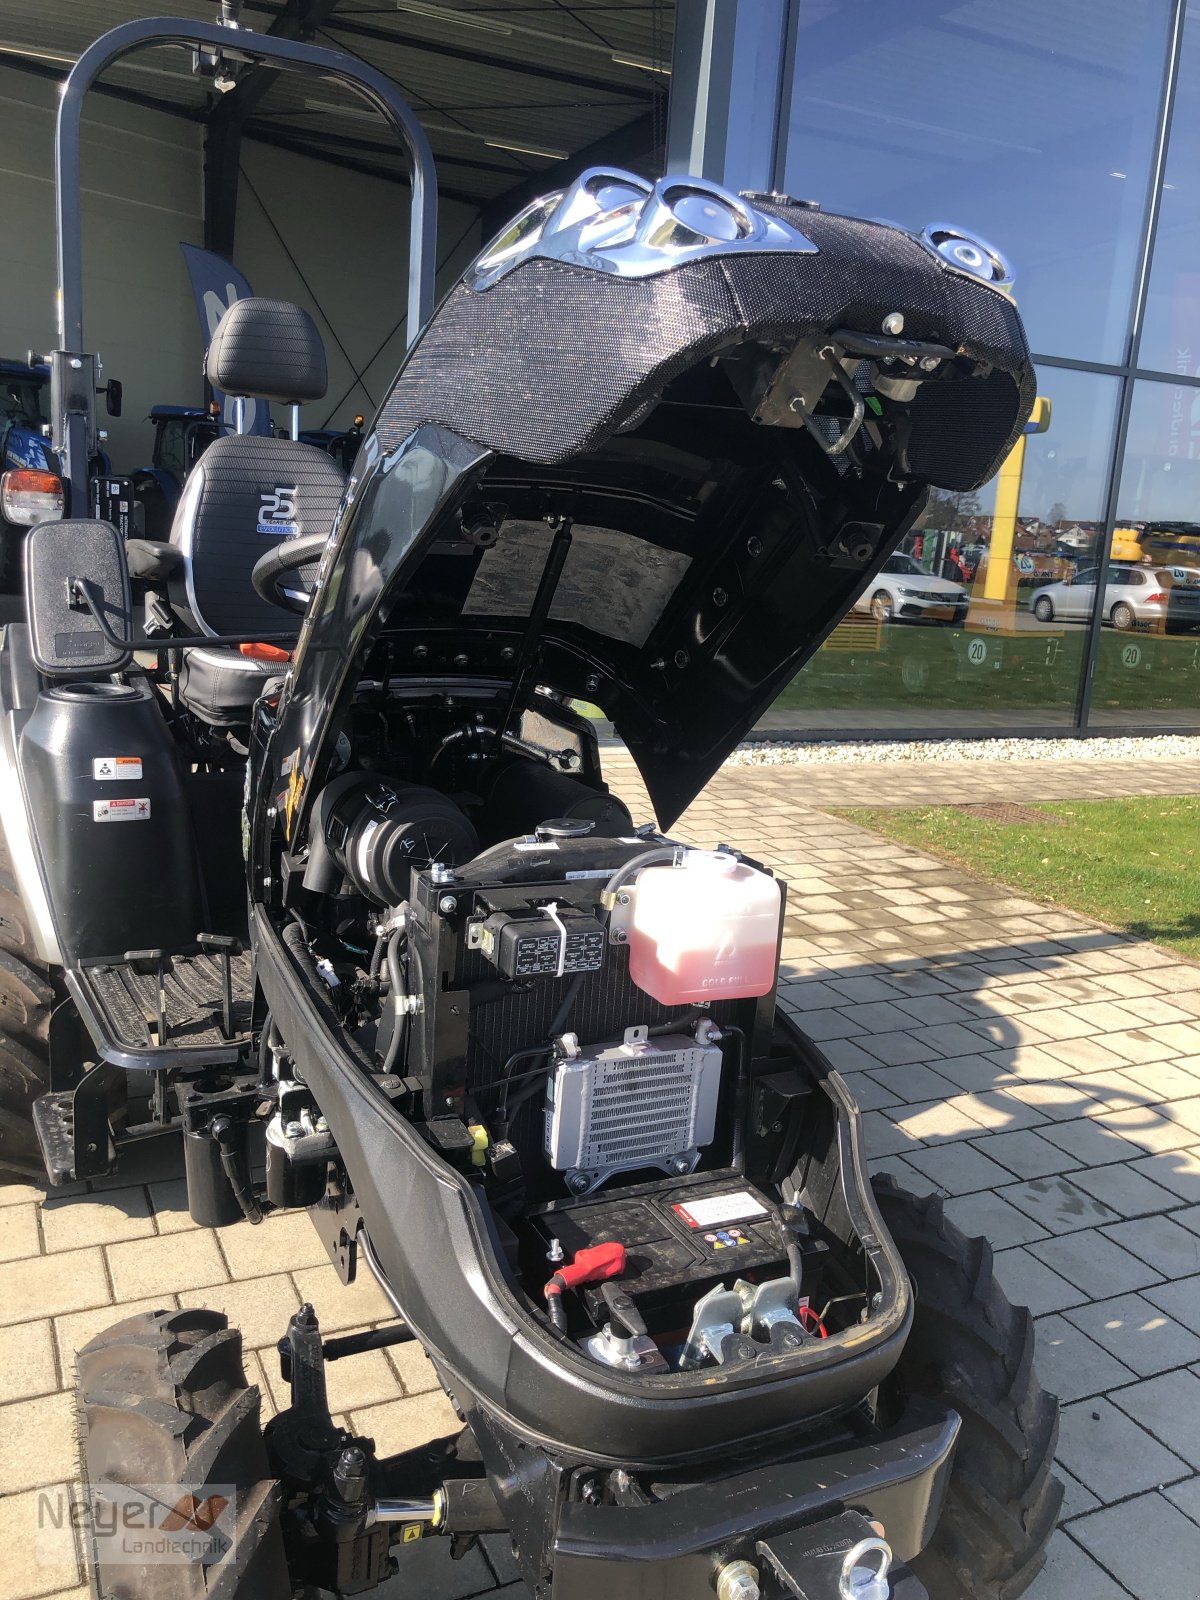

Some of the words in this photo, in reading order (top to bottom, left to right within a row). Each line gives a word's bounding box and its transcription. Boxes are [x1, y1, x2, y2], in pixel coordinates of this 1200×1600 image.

[258, 487, 297, 524] 25
[971, 643, 983, 660] 20
[1125, 648, 1138, 664] 20
